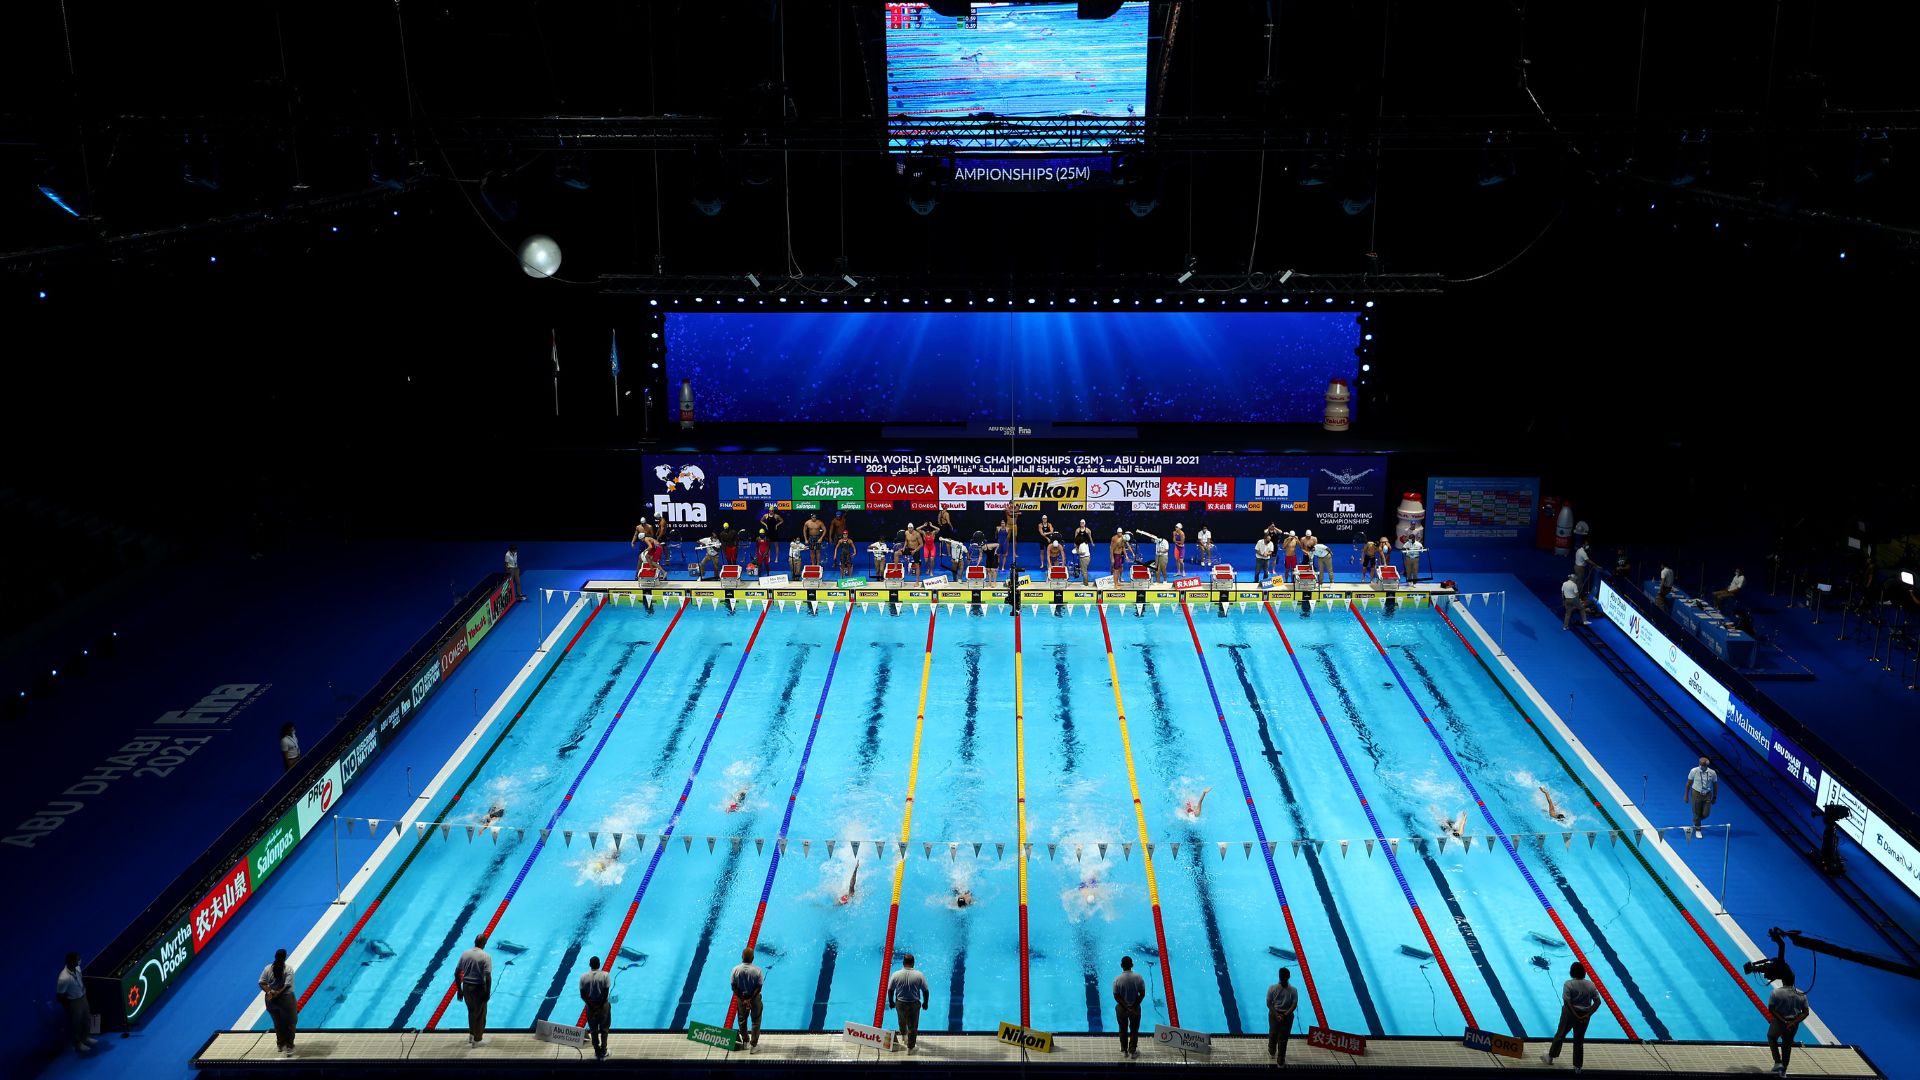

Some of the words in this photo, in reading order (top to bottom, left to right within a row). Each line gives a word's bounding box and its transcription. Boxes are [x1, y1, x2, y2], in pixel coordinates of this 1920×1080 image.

[1056, 166, 1090, 181] (25M)
[828, 456, 851, 464] 15TH
[854, 456, 879, 464] FINA
[884, 456, 922, 464] WORLD
[925, 456, 980, 464] SWIMMING
[984, 456, 1071, 464] CHAMPIONSHIPS
[1074, 456, 1103, 465] (25M)
[1114, 456, 1136, 464] ABU
[1140, 456, 1173, 464] DHABI
[1176, 456, 1199, 464] 2021
[738, 478, 771, 496] Fina
[802, 485, 853, 498] Salonpas
[887, 485, 934, 494] OMEGA
[943, 482, 1008, 495] Yakult
[1020, 482, 1079, 498] Nikon
[1126, 480, 1160, 489] Myrtha
[1126, 489, 1151, 497] Pools
[1167, 482, 1228, 497] 农夫山泉
[1255, 479, 1288, 496] Fina
[654, 494, 706, 522] Fina
[1333, 500, 1355, 512] Fina
[449, 637, 467, 664] OMEGA
[413, 679, 424, 706] NO
[1689, 677, 1702, 695] arena
[153, 684, 260, 724] Fina
[1735, 710, 1770, 751] Malmsten
[133, 736, 213, 778] 2021
[357, 737, 376, 766] NATION
[1774, 741, 1784, 756] ABU
[1785, 750, 1801, 769] DHABI
[343, 751, 357, 783] NO
[1787, 762, 1799, 778] 2021
[1802, 766, 1817, 789] Fina
[0, 801, 84, 848] ABU
[62, 736, 171, 795] DHABI
[257, 828, 294, 878] Salonpas
[1884, 841, 1904, 864] Daman
[196, 870, 247, 941] 农夫山泉
[160, 923, 192, 961] Myrtha
[163, 947, 187, 982] Pools
[553, 1026, 565, 1034] Abu
[566, 1028, 582, 1037] Dhabi
[692, 1030, 730, 1046] Salonpas
[847, 1028, 882, 1042] Yakult
[1002, 1026, 1045, 1048] Nikon
[1183, 1033, 1204, 1042] Myrtha
[1312, 1031, 1360, 1051] 农夫山泉
[1183, 1040, 1199, 1048] Pools
[1465, 1031, 1491, 1046] FINA
[1494, 1039, 1518, 1052] ORG
